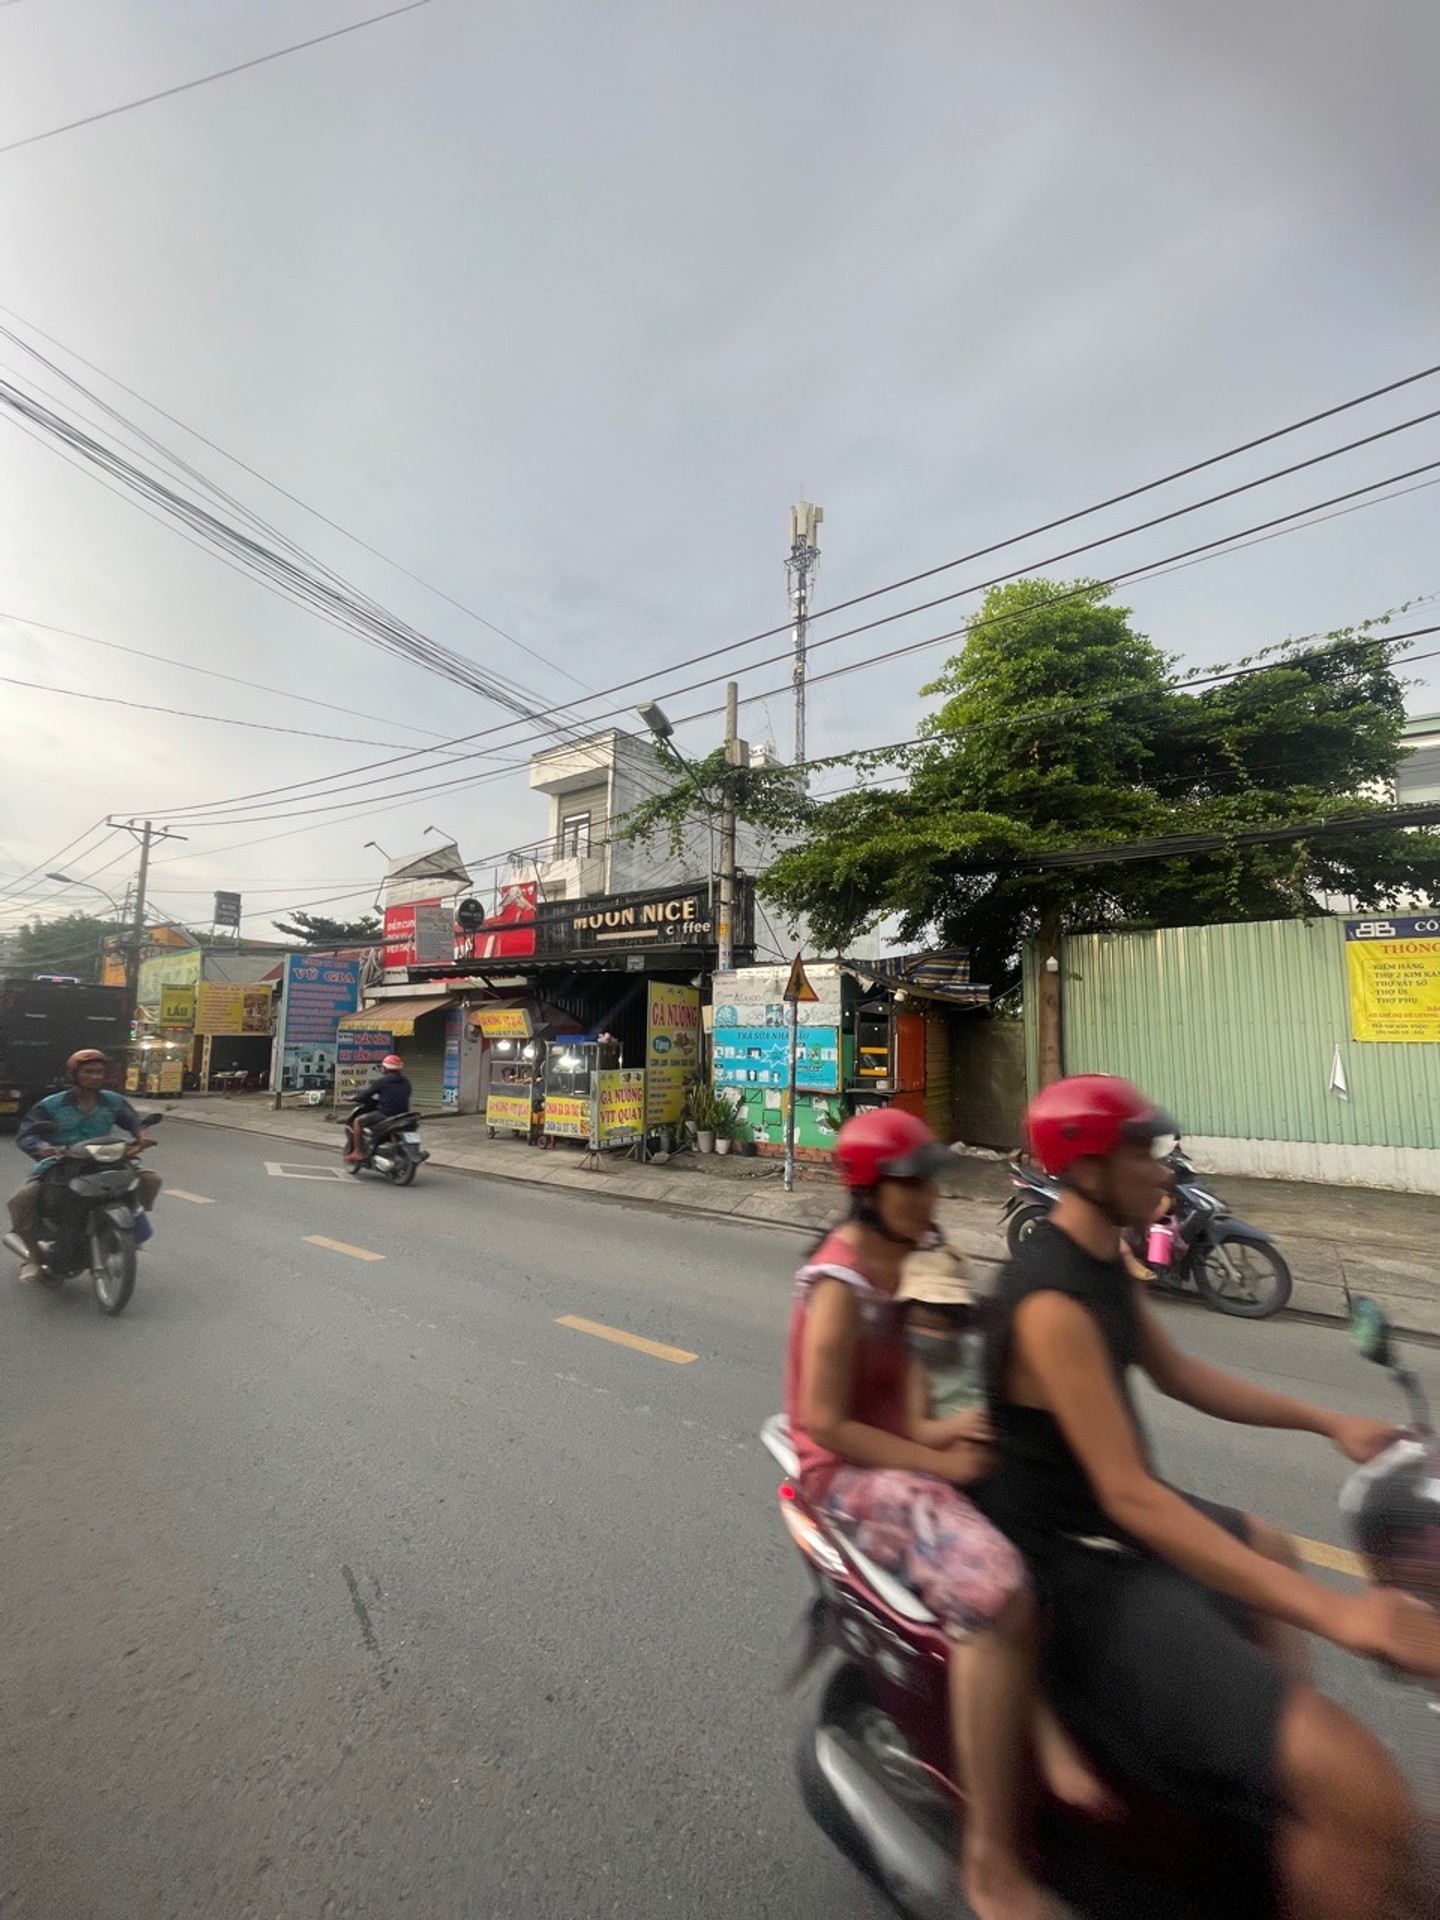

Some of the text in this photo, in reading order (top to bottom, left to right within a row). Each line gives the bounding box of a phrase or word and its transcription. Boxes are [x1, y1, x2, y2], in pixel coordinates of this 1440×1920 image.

[643, 899, 694, 924] NICE
[652, 996, 666, 1027] GÀ
[601, 1085, 613, 1105] GÀ
[618, 1107, 643, 1125] QUAY
